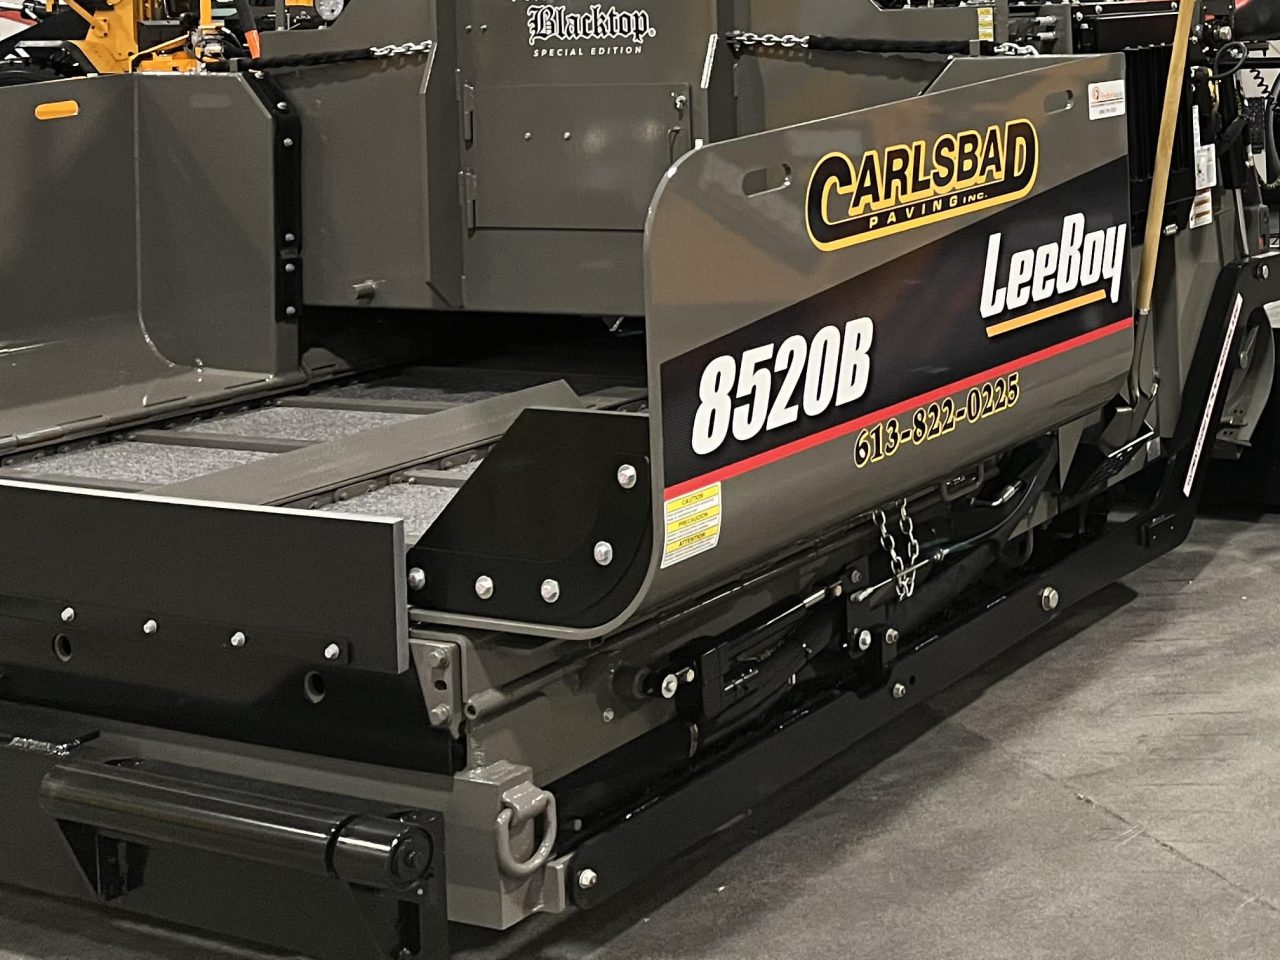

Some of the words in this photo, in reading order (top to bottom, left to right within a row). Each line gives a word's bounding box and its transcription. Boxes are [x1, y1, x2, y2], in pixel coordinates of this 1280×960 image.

[533, 49, 584, 58] SPECIAL
[590, 46, 642, 55] EDITION
[805, 118, 1039, 252] CARLSBAD
[869, 194, 959, 230] PAVING
[962, 192, 988, 204] INC.
[979, 212, 1127, 319] LeeBoy
[691, 317, 874, 455] 8520B
[853, 372, 1020, 469] 613-822-0225
